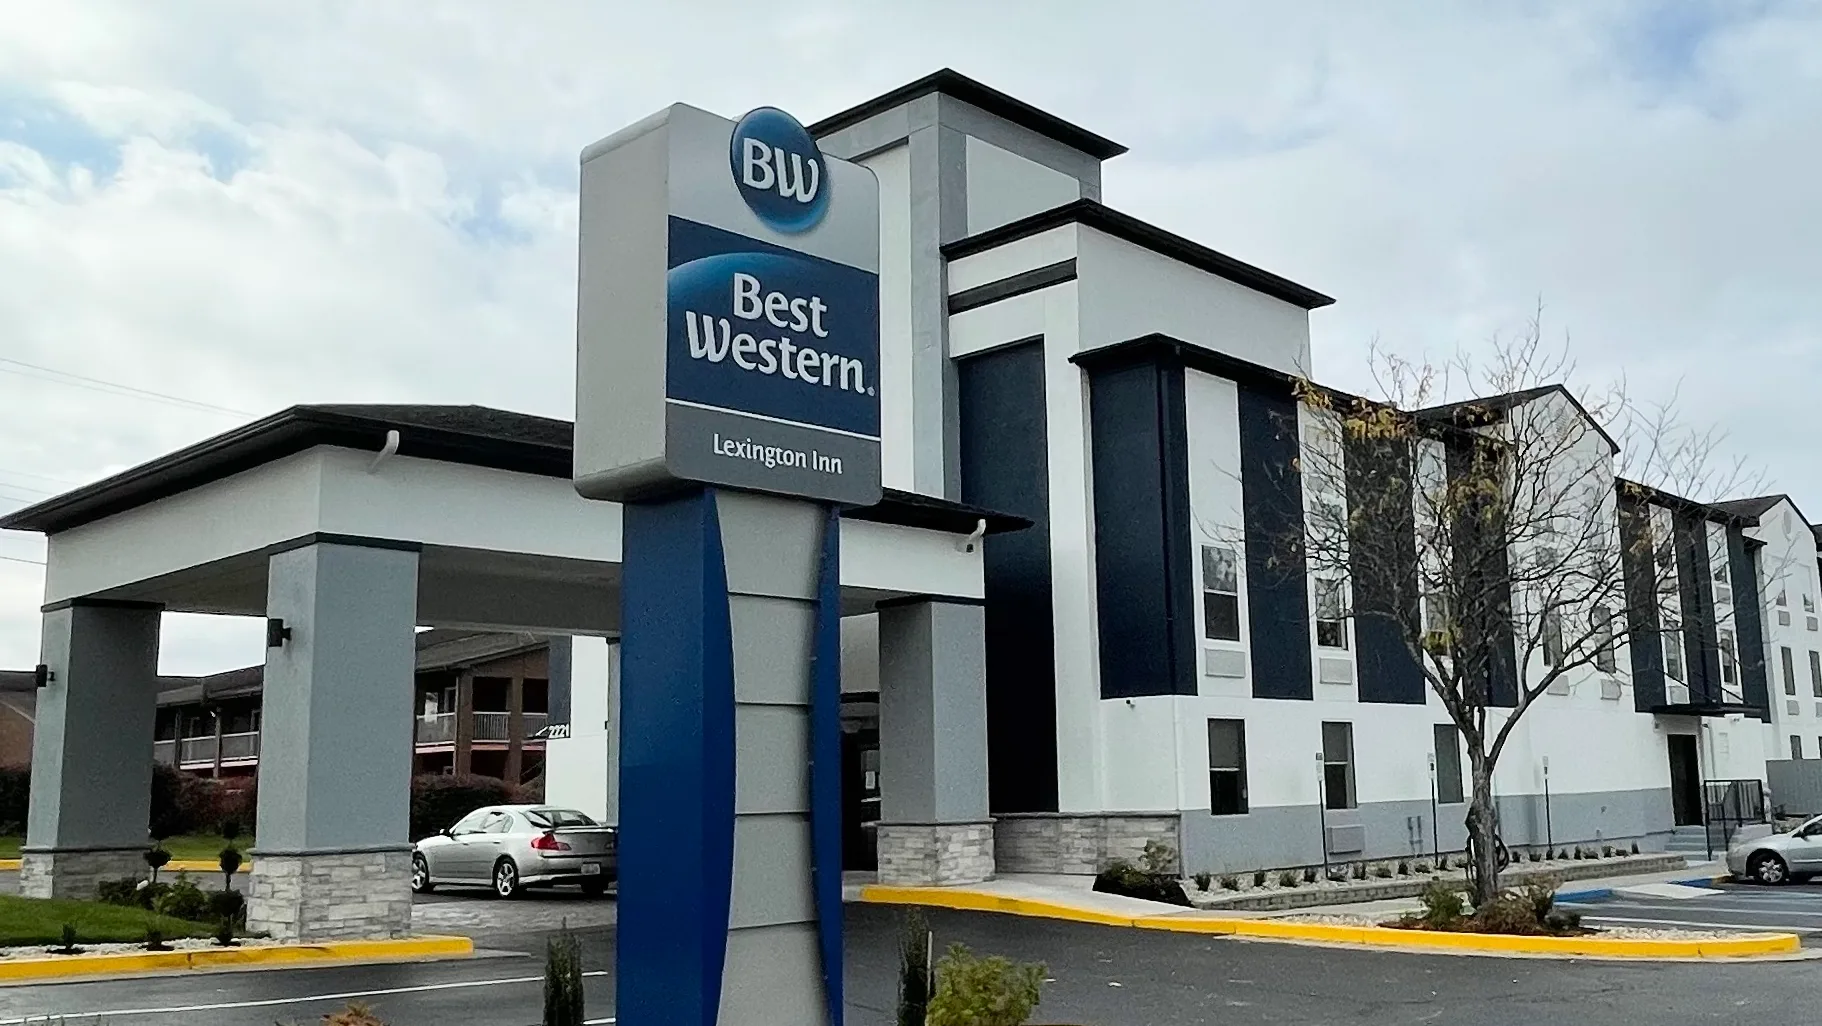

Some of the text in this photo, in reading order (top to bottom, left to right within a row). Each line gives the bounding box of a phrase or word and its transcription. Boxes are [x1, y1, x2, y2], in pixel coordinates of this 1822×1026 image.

[743, 137, 819, 203] BW
[733, 272, 829, 338] Best
[713, 433, 843, 474] Lexington Inn
